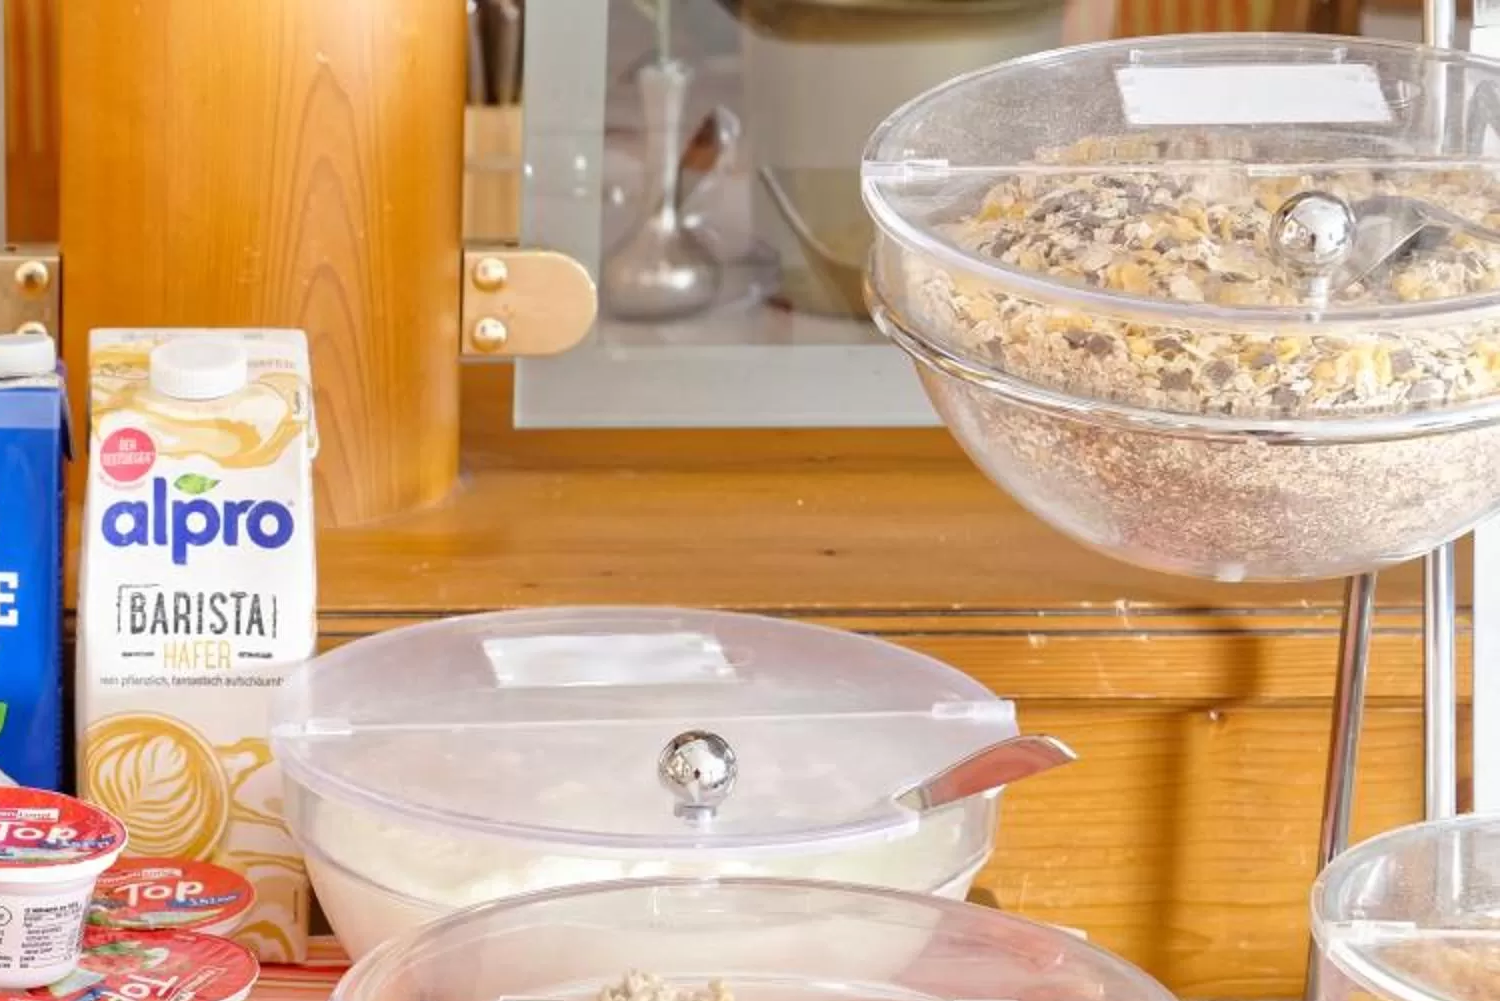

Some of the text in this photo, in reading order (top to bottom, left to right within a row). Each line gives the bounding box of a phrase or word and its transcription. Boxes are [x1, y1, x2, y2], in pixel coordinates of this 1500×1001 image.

[101, 476, 295, 565] alpro
[129, 591, 265, 637] BARISTA
[163, 639, 232, 669] HAFER
